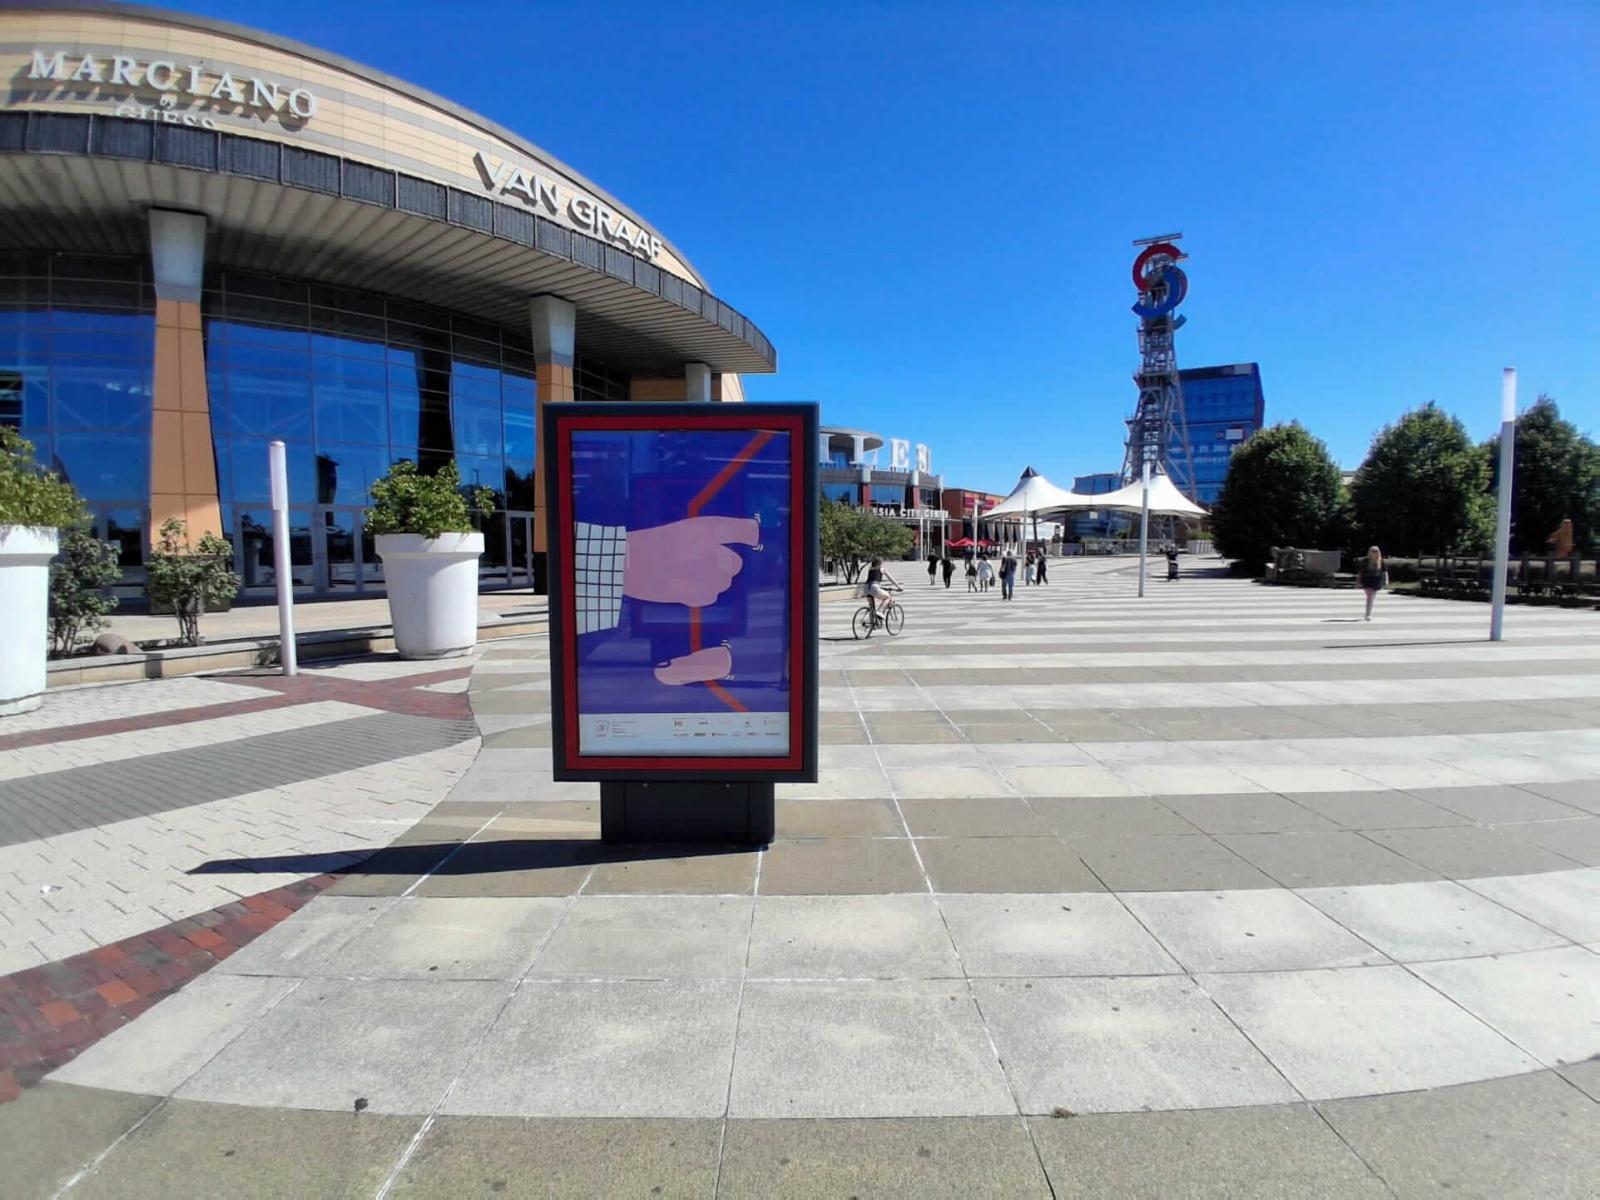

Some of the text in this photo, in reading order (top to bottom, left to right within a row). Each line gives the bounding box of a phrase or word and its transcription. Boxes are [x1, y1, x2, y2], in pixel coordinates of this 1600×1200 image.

[28, 49, 317, 118] MARCIANO
[475, 151, 663, 258] VAN GRAAF
